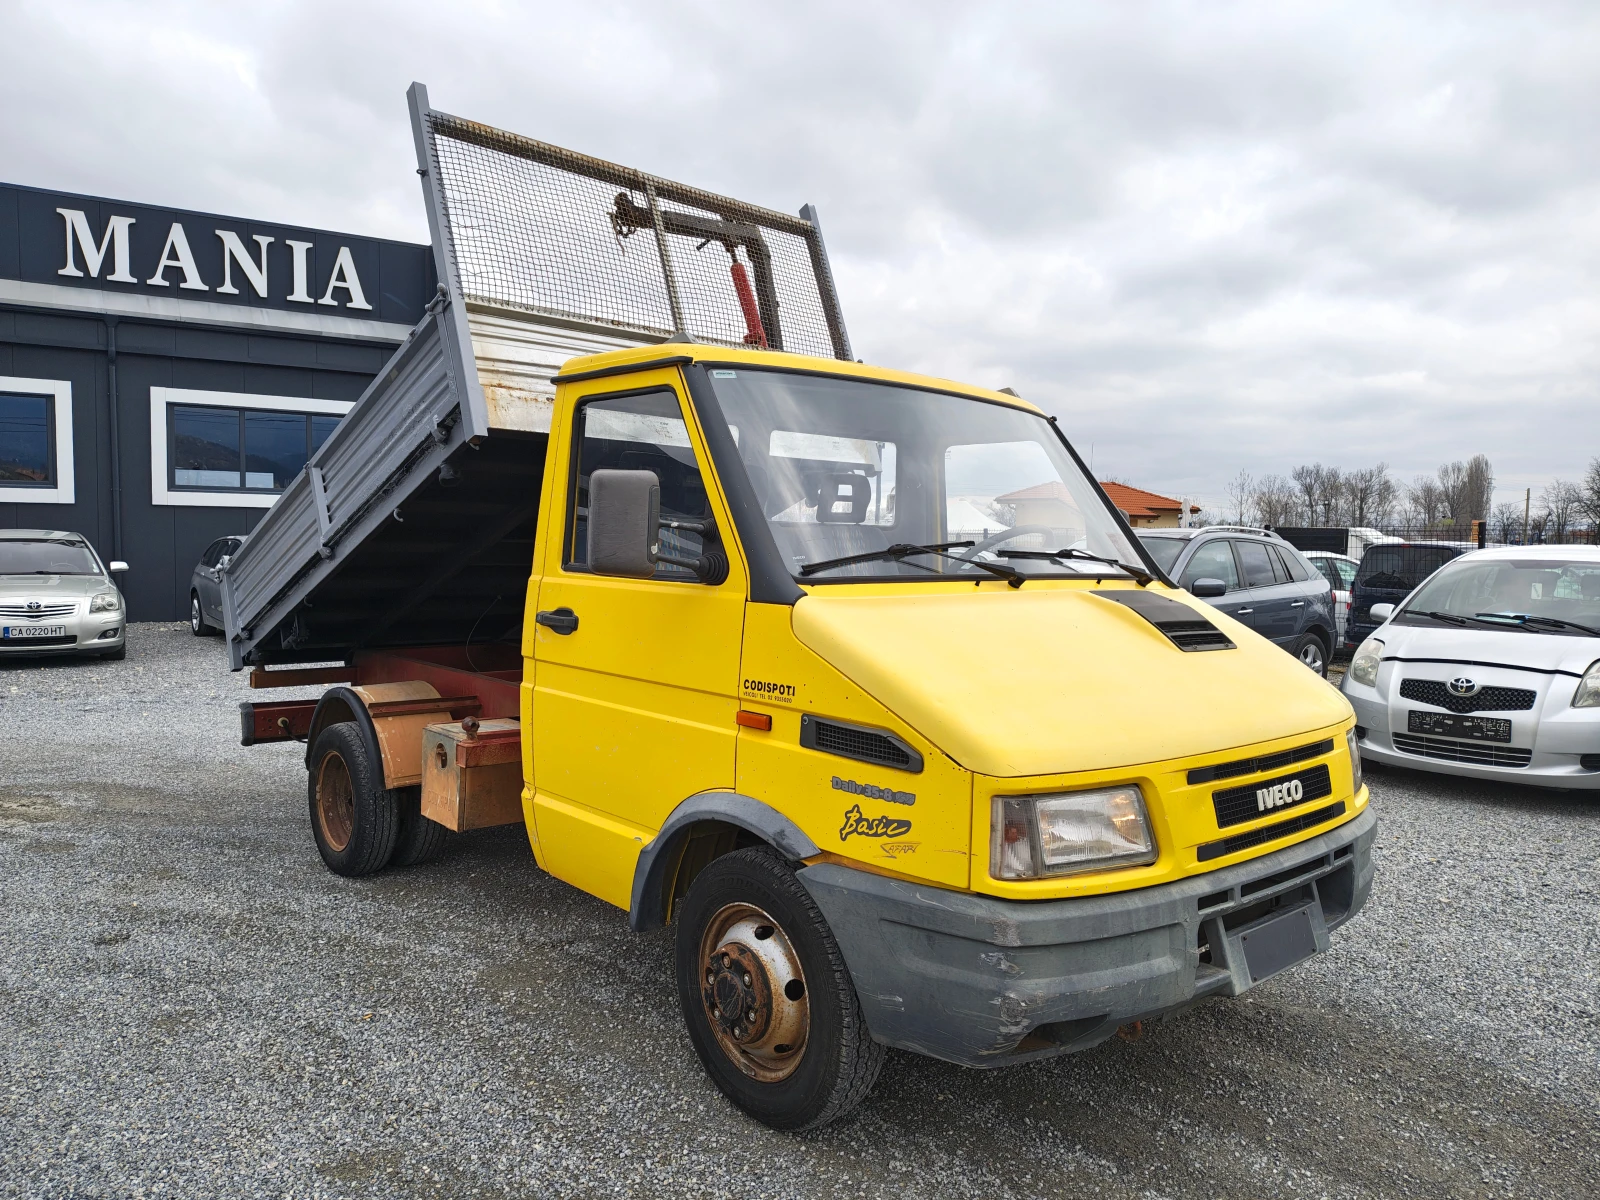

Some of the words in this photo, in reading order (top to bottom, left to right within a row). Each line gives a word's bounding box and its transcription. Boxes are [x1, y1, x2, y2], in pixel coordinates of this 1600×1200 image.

[56, 207, 373, 311] MANIA
[11, 628, 24, 636] CA
[25, 627, 49, 636] 0220
[50, 626, 63, 635] HT
[743, 679, 795, 696] CODISPOTI
[832, 776, 863, 795] Daily
[1256, 779, 1303, 812] IVECO
[839, 804, 912, 841] Basic
